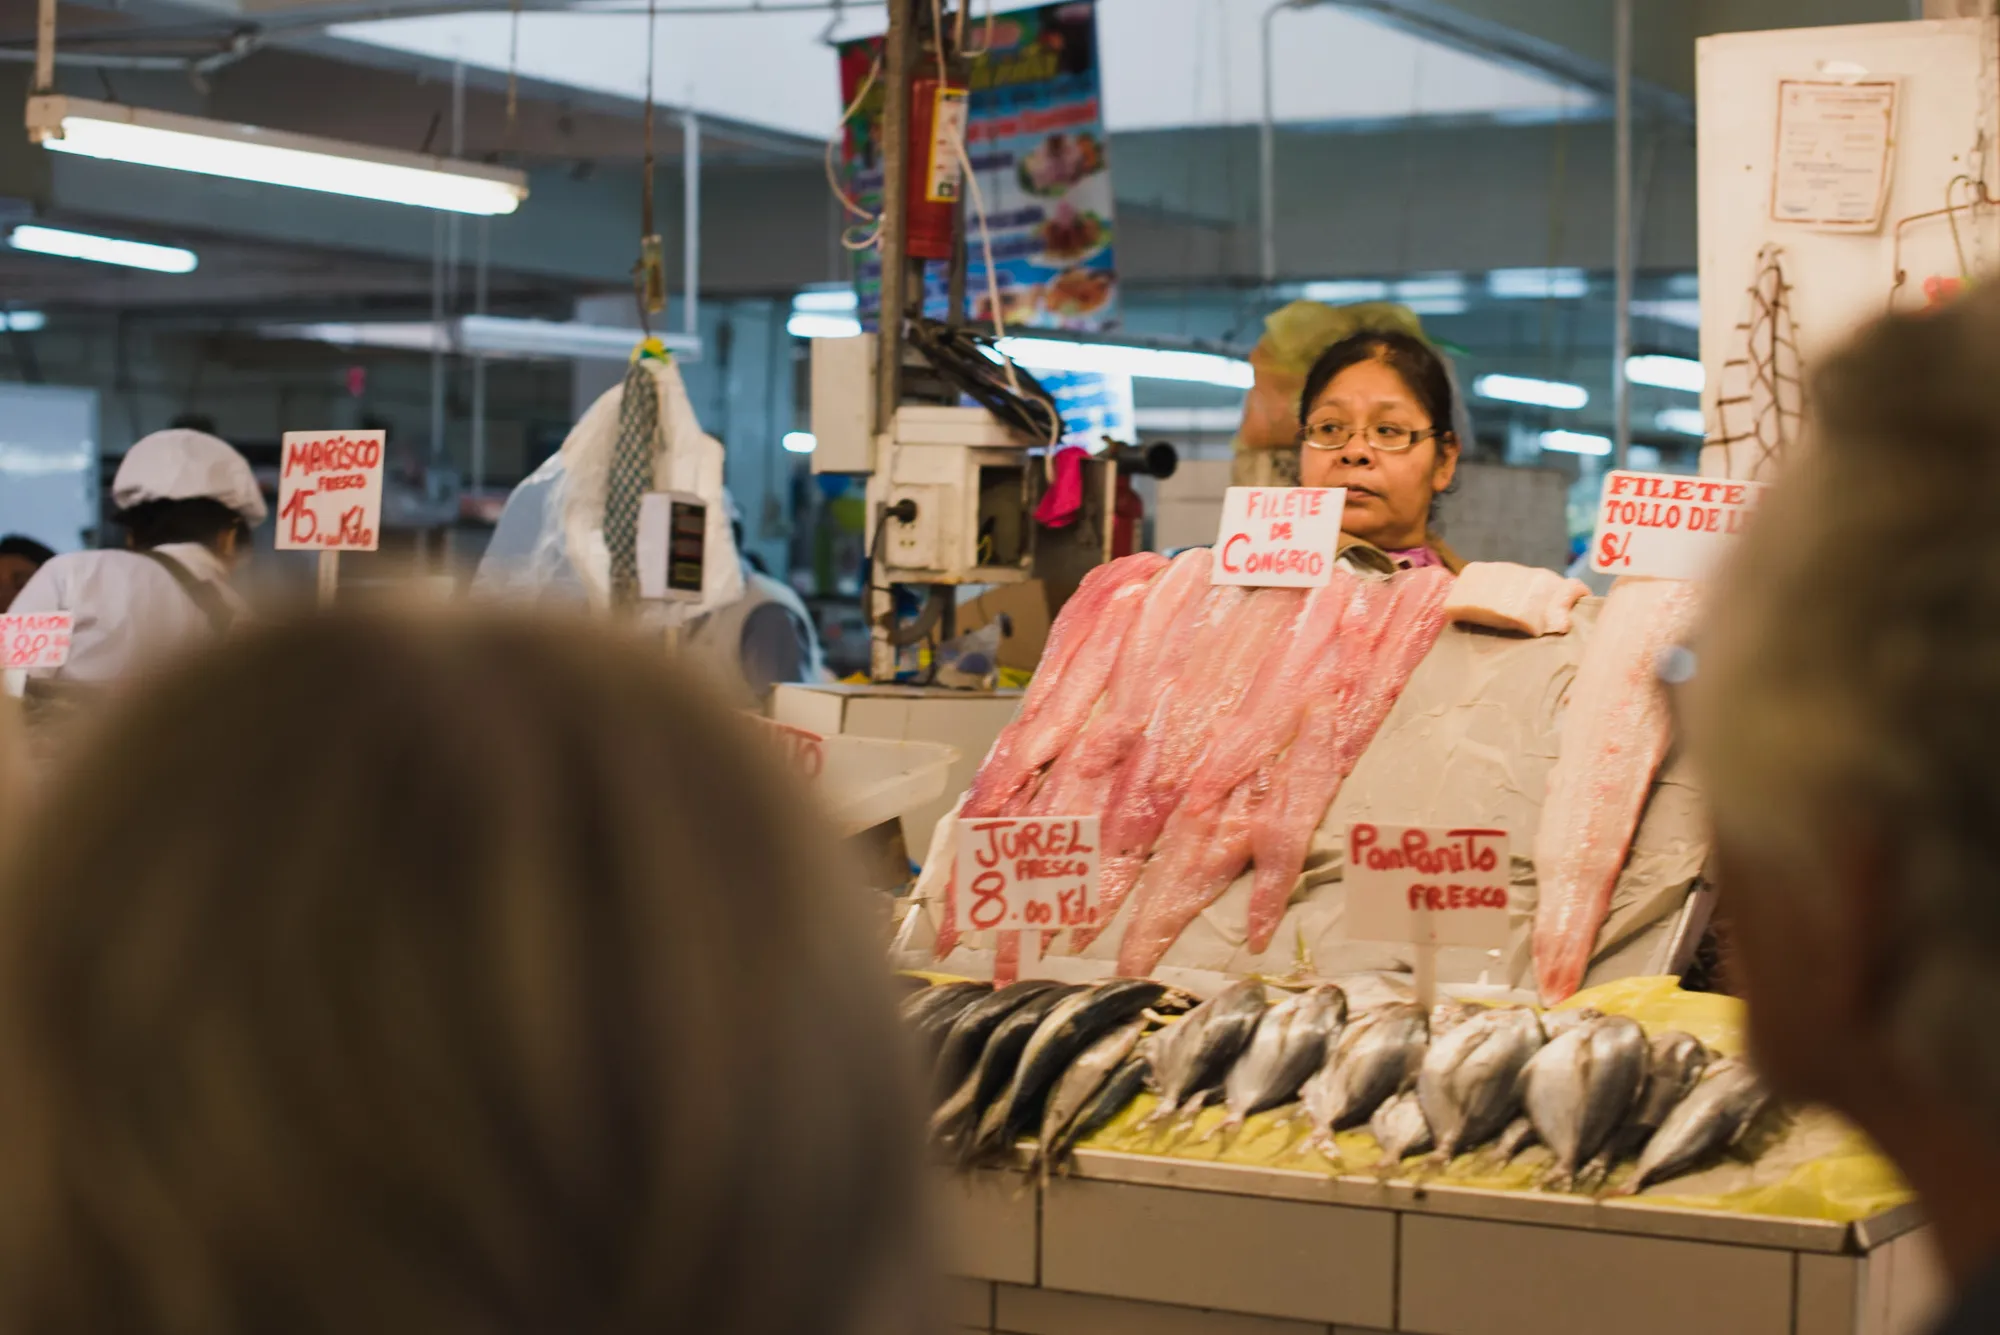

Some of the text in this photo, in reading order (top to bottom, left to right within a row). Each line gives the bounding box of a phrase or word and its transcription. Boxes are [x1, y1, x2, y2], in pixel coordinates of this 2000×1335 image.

[285, 436, 379, 477] MARISCO
[1246, 489, 1329, 519] FILETE
[1609, 476, 1746, 504] FILETE
[1606, 500, 1681, 528] TOLLO
[1687, 507, 1720, 532] DE
[1270, 521, 1292, 541] DE
[972, 821, 1093, 867] JUREL
[1015, 859, 1089, 881] FRESCO
[1407, 884, 1508, 910] FRESCO
